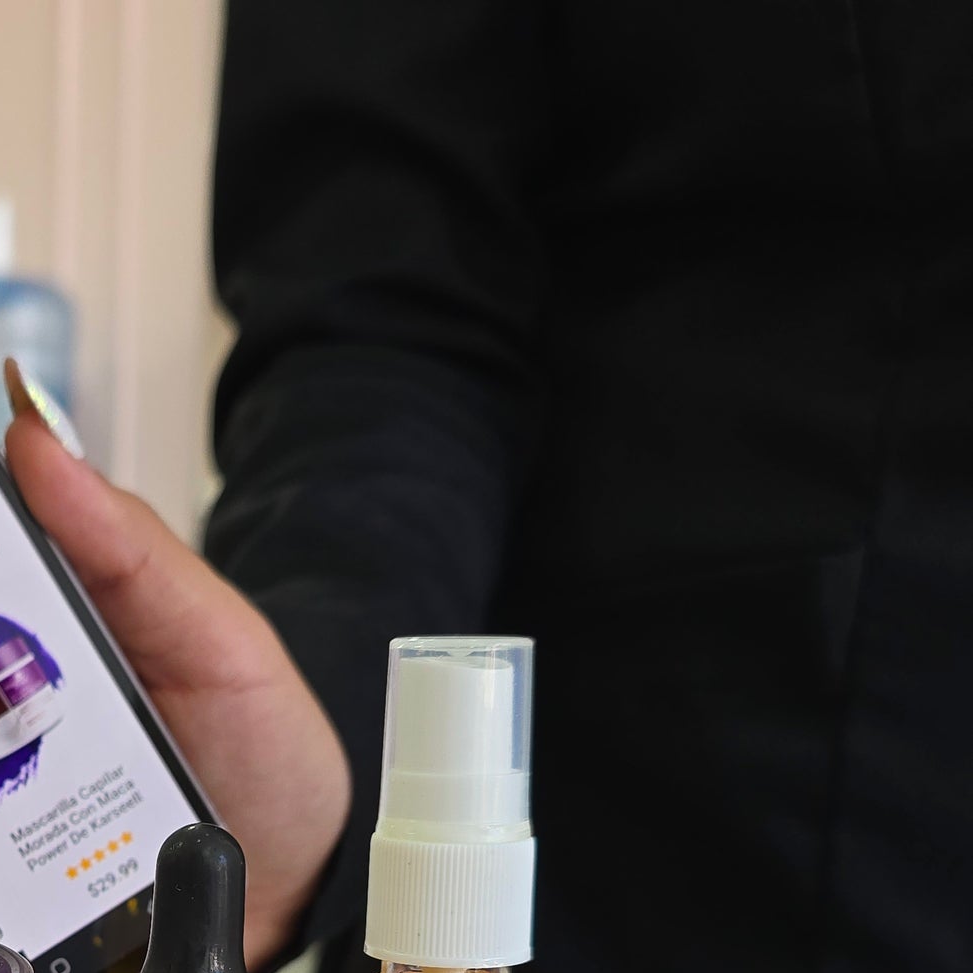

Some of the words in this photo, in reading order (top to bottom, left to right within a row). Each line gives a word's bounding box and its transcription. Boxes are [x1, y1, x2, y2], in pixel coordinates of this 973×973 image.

[9, 794, 78, 844] Mascarilla
[77, 764, 127, 802] Capilar
[18, 819, 69, 858] Morada
[68, 801, 97, 826] Con
[96, 776, 135, 808] Maca
[26, 837, 69, 871] Power
[68, 824, 90, 845] De
[88, 789, 144, 832] Karseell
[86, 857, 141, 899] $29.99
